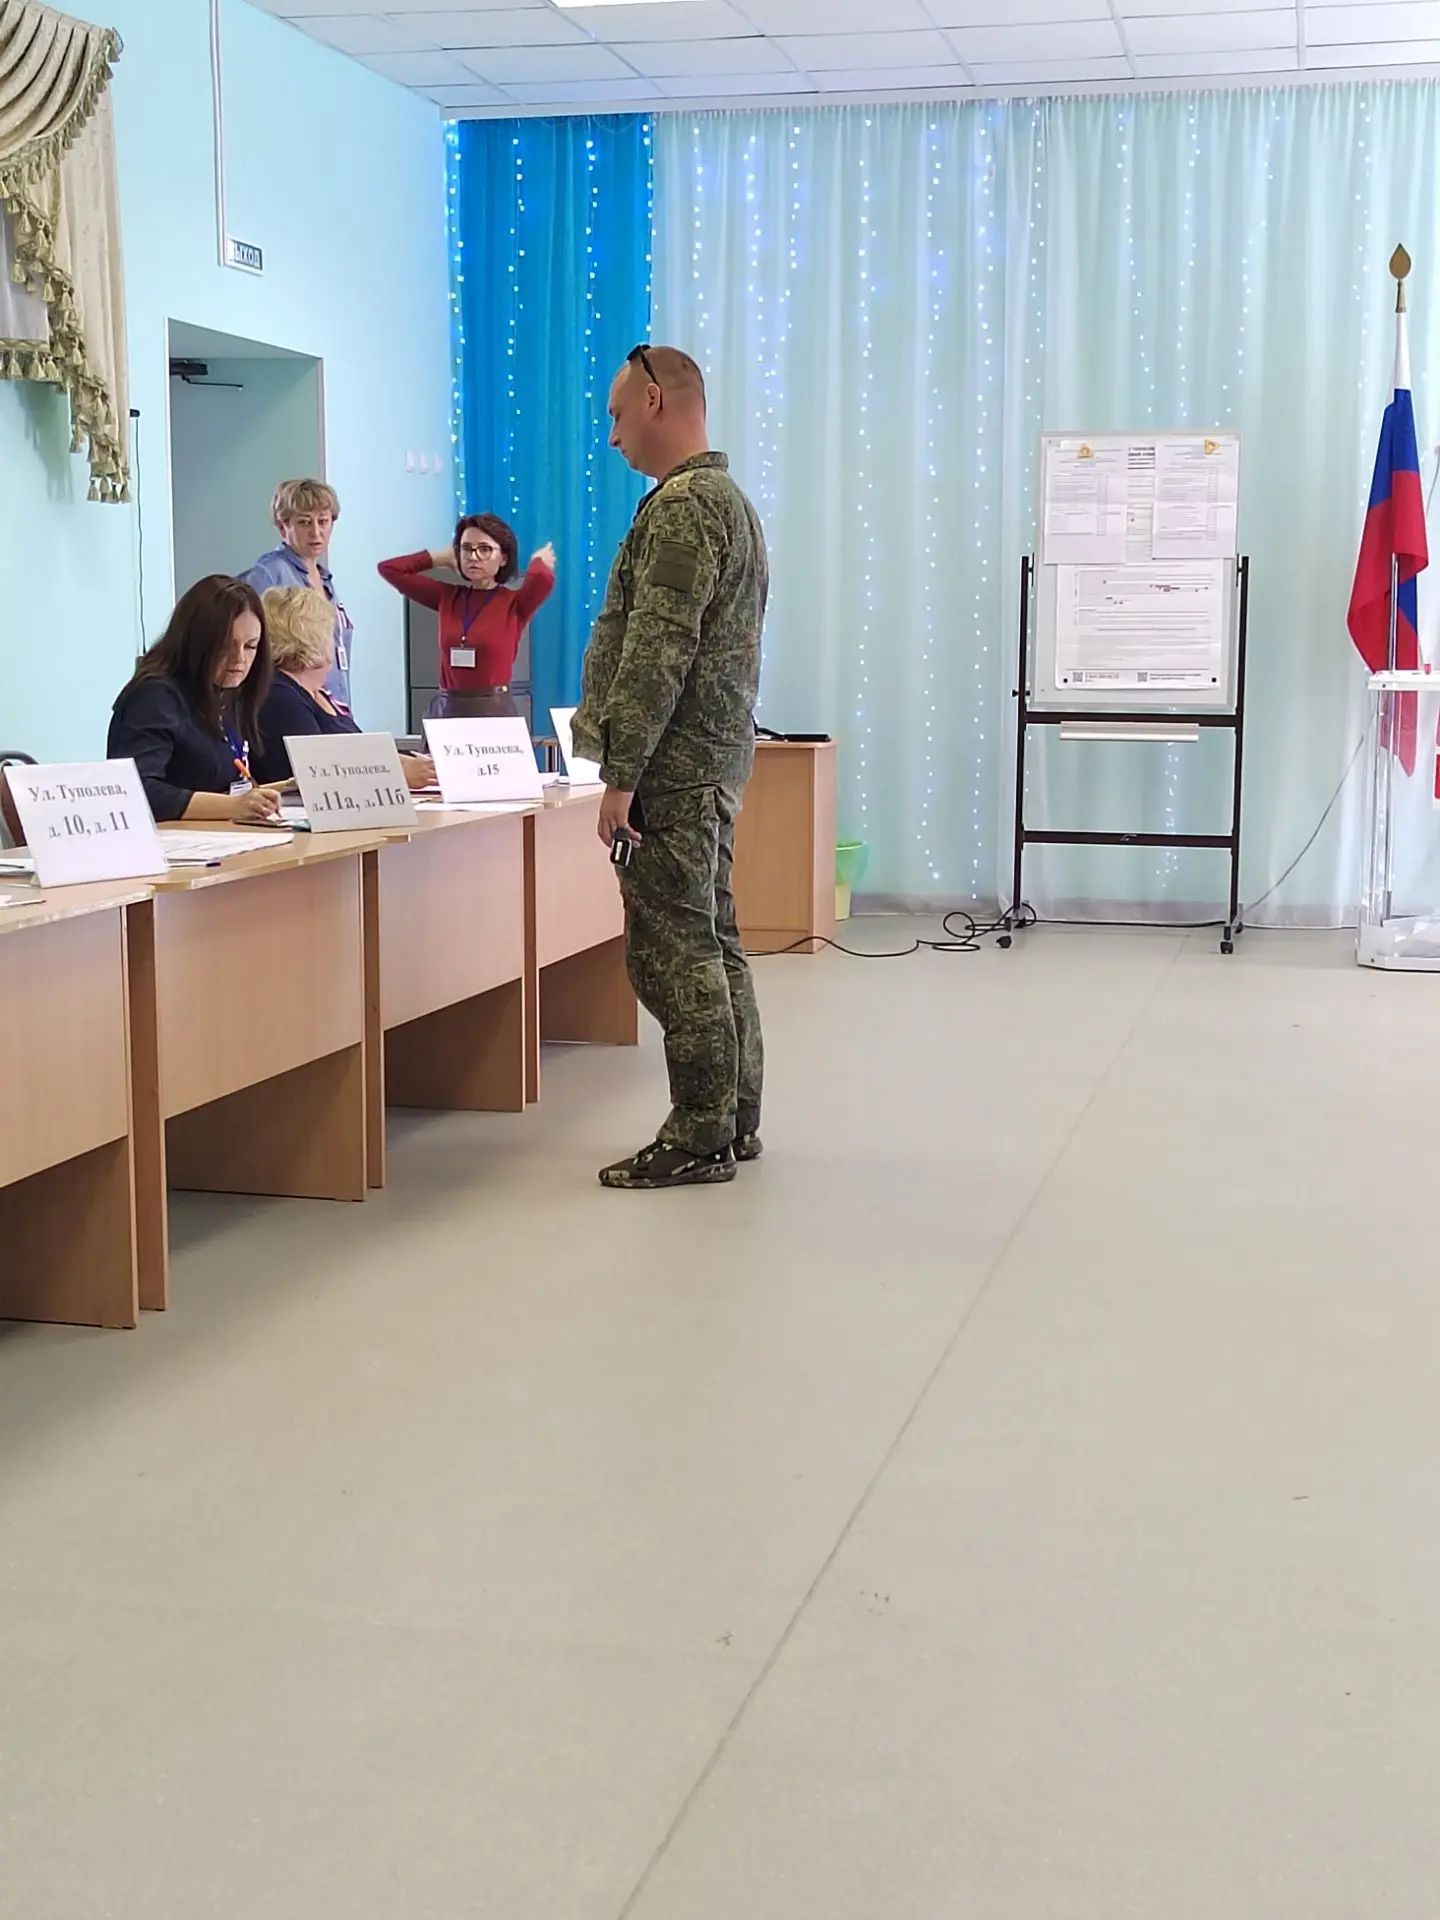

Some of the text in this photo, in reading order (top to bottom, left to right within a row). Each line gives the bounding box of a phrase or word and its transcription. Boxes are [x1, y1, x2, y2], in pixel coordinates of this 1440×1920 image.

[231, 241, 261, 268] ЫХОД
[443, 743, 524, 758] Ул. Туполева,
[309, 763, 391, 778] Ул. Туполева,
[28, 783, 128, 803] Ул. Туполева,
[63, 813, 92, 837] 10,
[109, 810, 130, 831] 11
